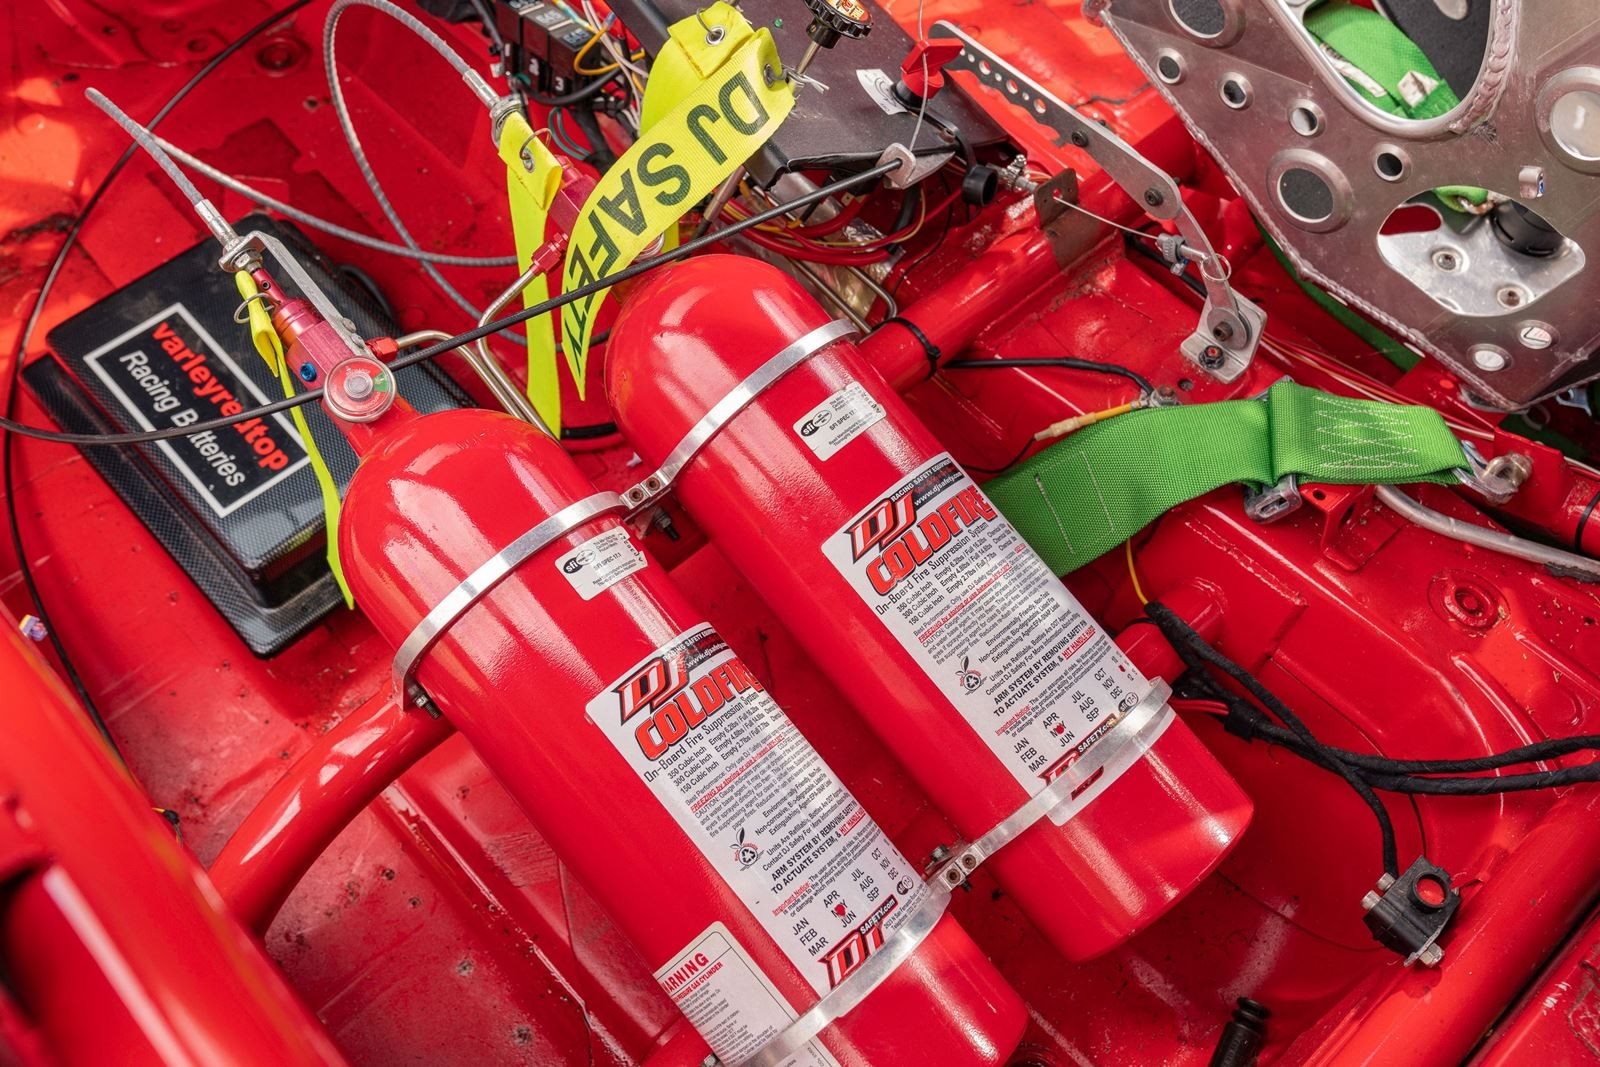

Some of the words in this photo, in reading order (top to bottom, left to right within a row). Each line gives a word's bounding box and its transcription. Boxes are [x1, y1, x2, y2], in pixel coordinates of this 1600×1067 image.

[555, 76, 564, 91] 3
[686, 71, 770, 165] DJ
[565, 142, 691, 376] SAFETY
[119, 350, 181, 412] Racing
[171, 408, 245, 487] Btteries
[890, 481, 914, 502] RACING
[912, 469, 933, 485] SAFETY
[843, 489, 916, 563] DJ
[863, 484, 997, 595] COLDFIRE
[874, 579, 915, 615] On-Board
[911, 565, 930, 583] Fire
[927, 533, 972, 573] Suppression
[967, 518, 990, 541] System
[896, 601, 908, 612] 350
[905, 589, 922, 604] Cubic
[919, 579, 933, 592] Inch
[934, 565, 952, 581] Empty
[901, 607, 913, 618] 300
[910, 595, 928, 611] Cubic
[925, 586, 938, 599] Inch
[939, 571, 957, 587] Empty
[907, 614, 919, 625] 150
[916, 602, 934, 618] Cubic
[930, 593, 945, 606] Inch
[945, 578, 963, 594] Empty
[611, 652, 688, 725] DJ
[985, 677, 1006, 696] Contact
[1003, 671, 1012, 680] DJ
[1010, 659, 1027, 675] Safety
[1024, 652, 1034, 662] For
[1031, 643, 1045, 655] More
[989, 668, 1004, 682] Units
[1001, 660, 1012, 671] Are
[992, 688, 1010, 704] ARM
[1007, 666, 1035, 692] SYSTEM
[1032, 659, 1043, 670] BY
[1041, 635, 1070, 663] REMOVING
[993, 705, 1005, 717] TO
[1003, 680, 1035, 709] ACTUATE
[1032, 658, 1060, 684] SYSTEM,
[1056, 654, 1064, 662] &
[1061, 646, 1072, 658] HIT
[631, 655, 764, 761] COLDFIR
[643, 744, 687, 782] On-Board
[684, 730, 703, 748] Fire
[701, 698, 744, 736] Suppression
[1011, 736, 1030, 754] JAN
[1041, 711, 1060, 729] APR
[1069, 688, 1086, 704] JUL
[1093, 667, 1108, 681] OCT
[1019, 746, 1038, 763] FEB
[1049, 720, 1068, 738] MY
[1077, 696, 1095, 713] AUG
[1101, 675, 1116, 690] NOV
[1028, 754, 1048, 772] MAR
[1057, 730, 1075, 747] JUN
[1085, 706, 1102, 722] SEP
[1109, 685, 1123, 699] DEC
[1076, 714, 1116, 753] SAFETY.c
[667, 767, 679, 779] 350
[677, 754, 695, 771] Cubic
[693, 745, 707, 758] Inch
[708, 729, 726, 746] Empty
[673, 775, 685, 786] 300
[683, 761, 701, 778] Cubic
[698, 752, 713, 765] Inch
[714, 736, 732, 753] Empty
[679, 782, 692, 794] 150
[689, 769, 707, 786] Cubic
[704, 759, 719, 773] Inch
[720, 744, 738, 761] Empty
[761, 851, 783, 871] Contact
[781, 845, 791, 855] DJ
[788, 833, 805, 849] Safety
[802, 826, 812, 835] For
[770, 863, 788, 881] ARM
[785, 840, 813, 867] SYSTEM
[810, 833, 822, 845] BY
[819, 812, 845, 837] REMOVING
[770, 882, 784, 895] TO
[781, 855, 814, 886] ACTUATE
[811, 834, 837, 859] SYSTEM,
[834, 830, 841, 838] &
[789, 917, 810, 936] JAN
[821, 889, 841, 908] APR
[849, 866, 865, 882] JUL
[870, 847, 883, 860] OCT
[798, 927, 818, 945] FEB
[829, 899, 850, 918] MY
[857, 874, 875, 891] AUG
[878, 856, 892, 870] NOV
[807, 935, 829, 956] MAR
[838, 910, 857, 928] JUN
[865, 886, 882, 902] SEP
[886, 867, 900, 880] DEC
[859, 898, 895, 934] SAFETY.com
[698, 961, 723, 983] CYLINDER
